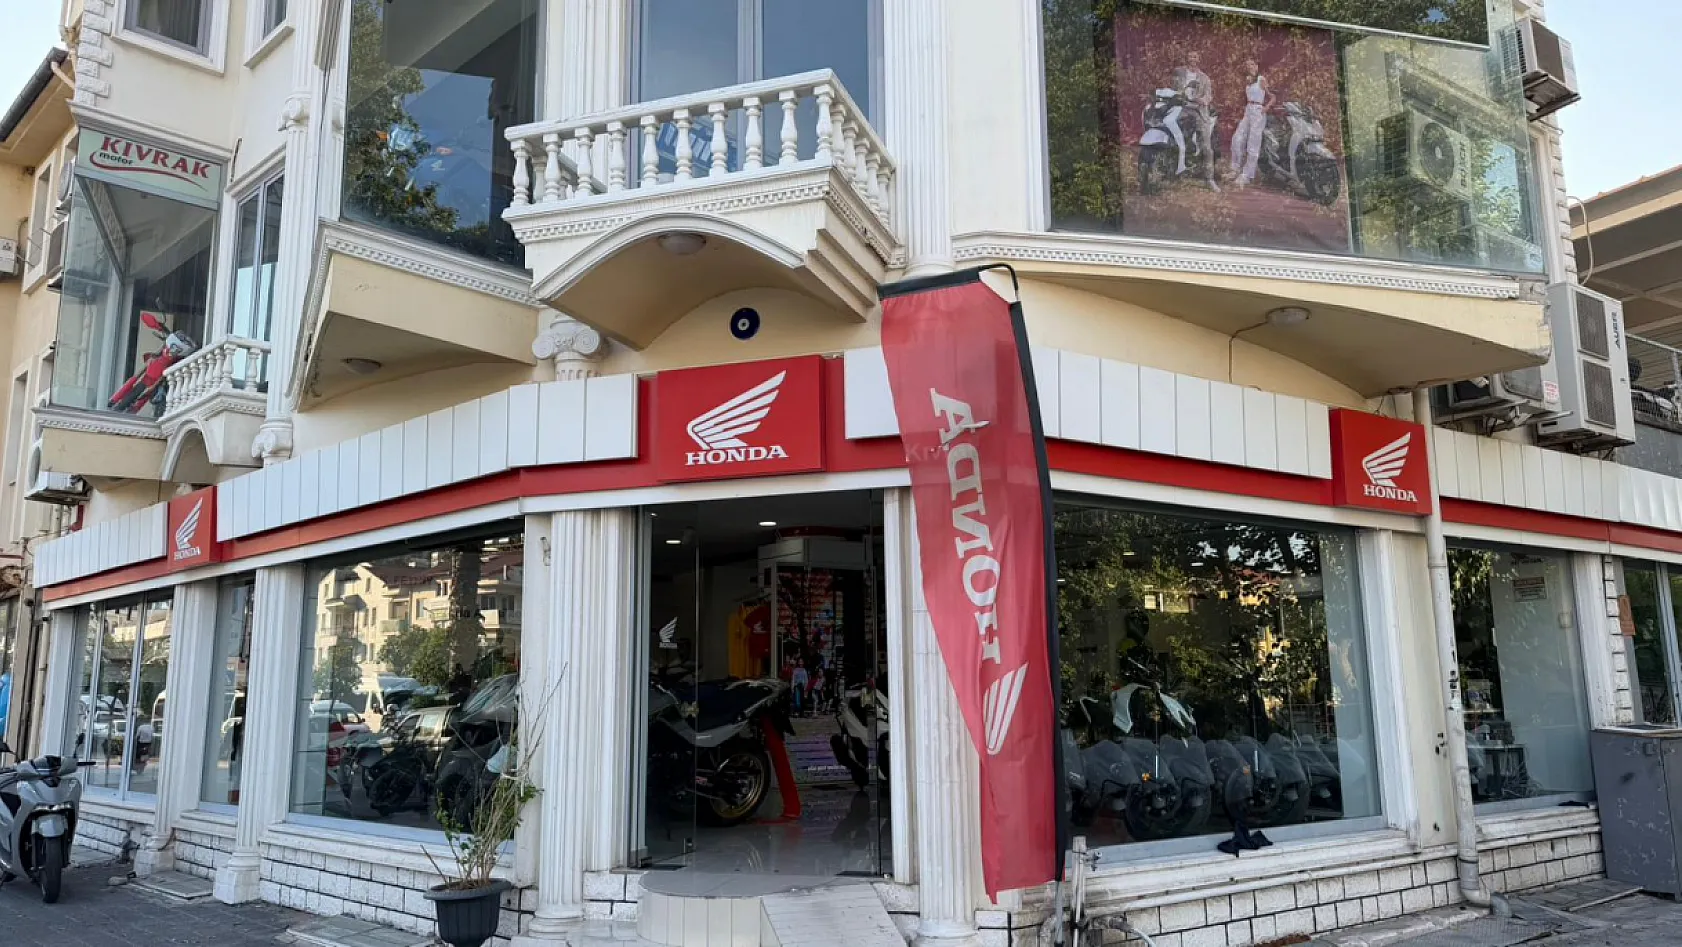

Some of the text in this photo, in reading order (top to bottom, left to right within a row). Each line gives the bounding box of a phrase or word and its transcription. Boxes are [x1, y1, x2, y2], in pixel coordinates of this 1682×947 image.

[99, 152, 134, 166] motor
[100, 135, 212, 178] KIVRAK
[685, 444, 789, 466] HONDA
[1363, 483, 1418, 502] HONDA
[173, 546, 201, 561] HONDA
